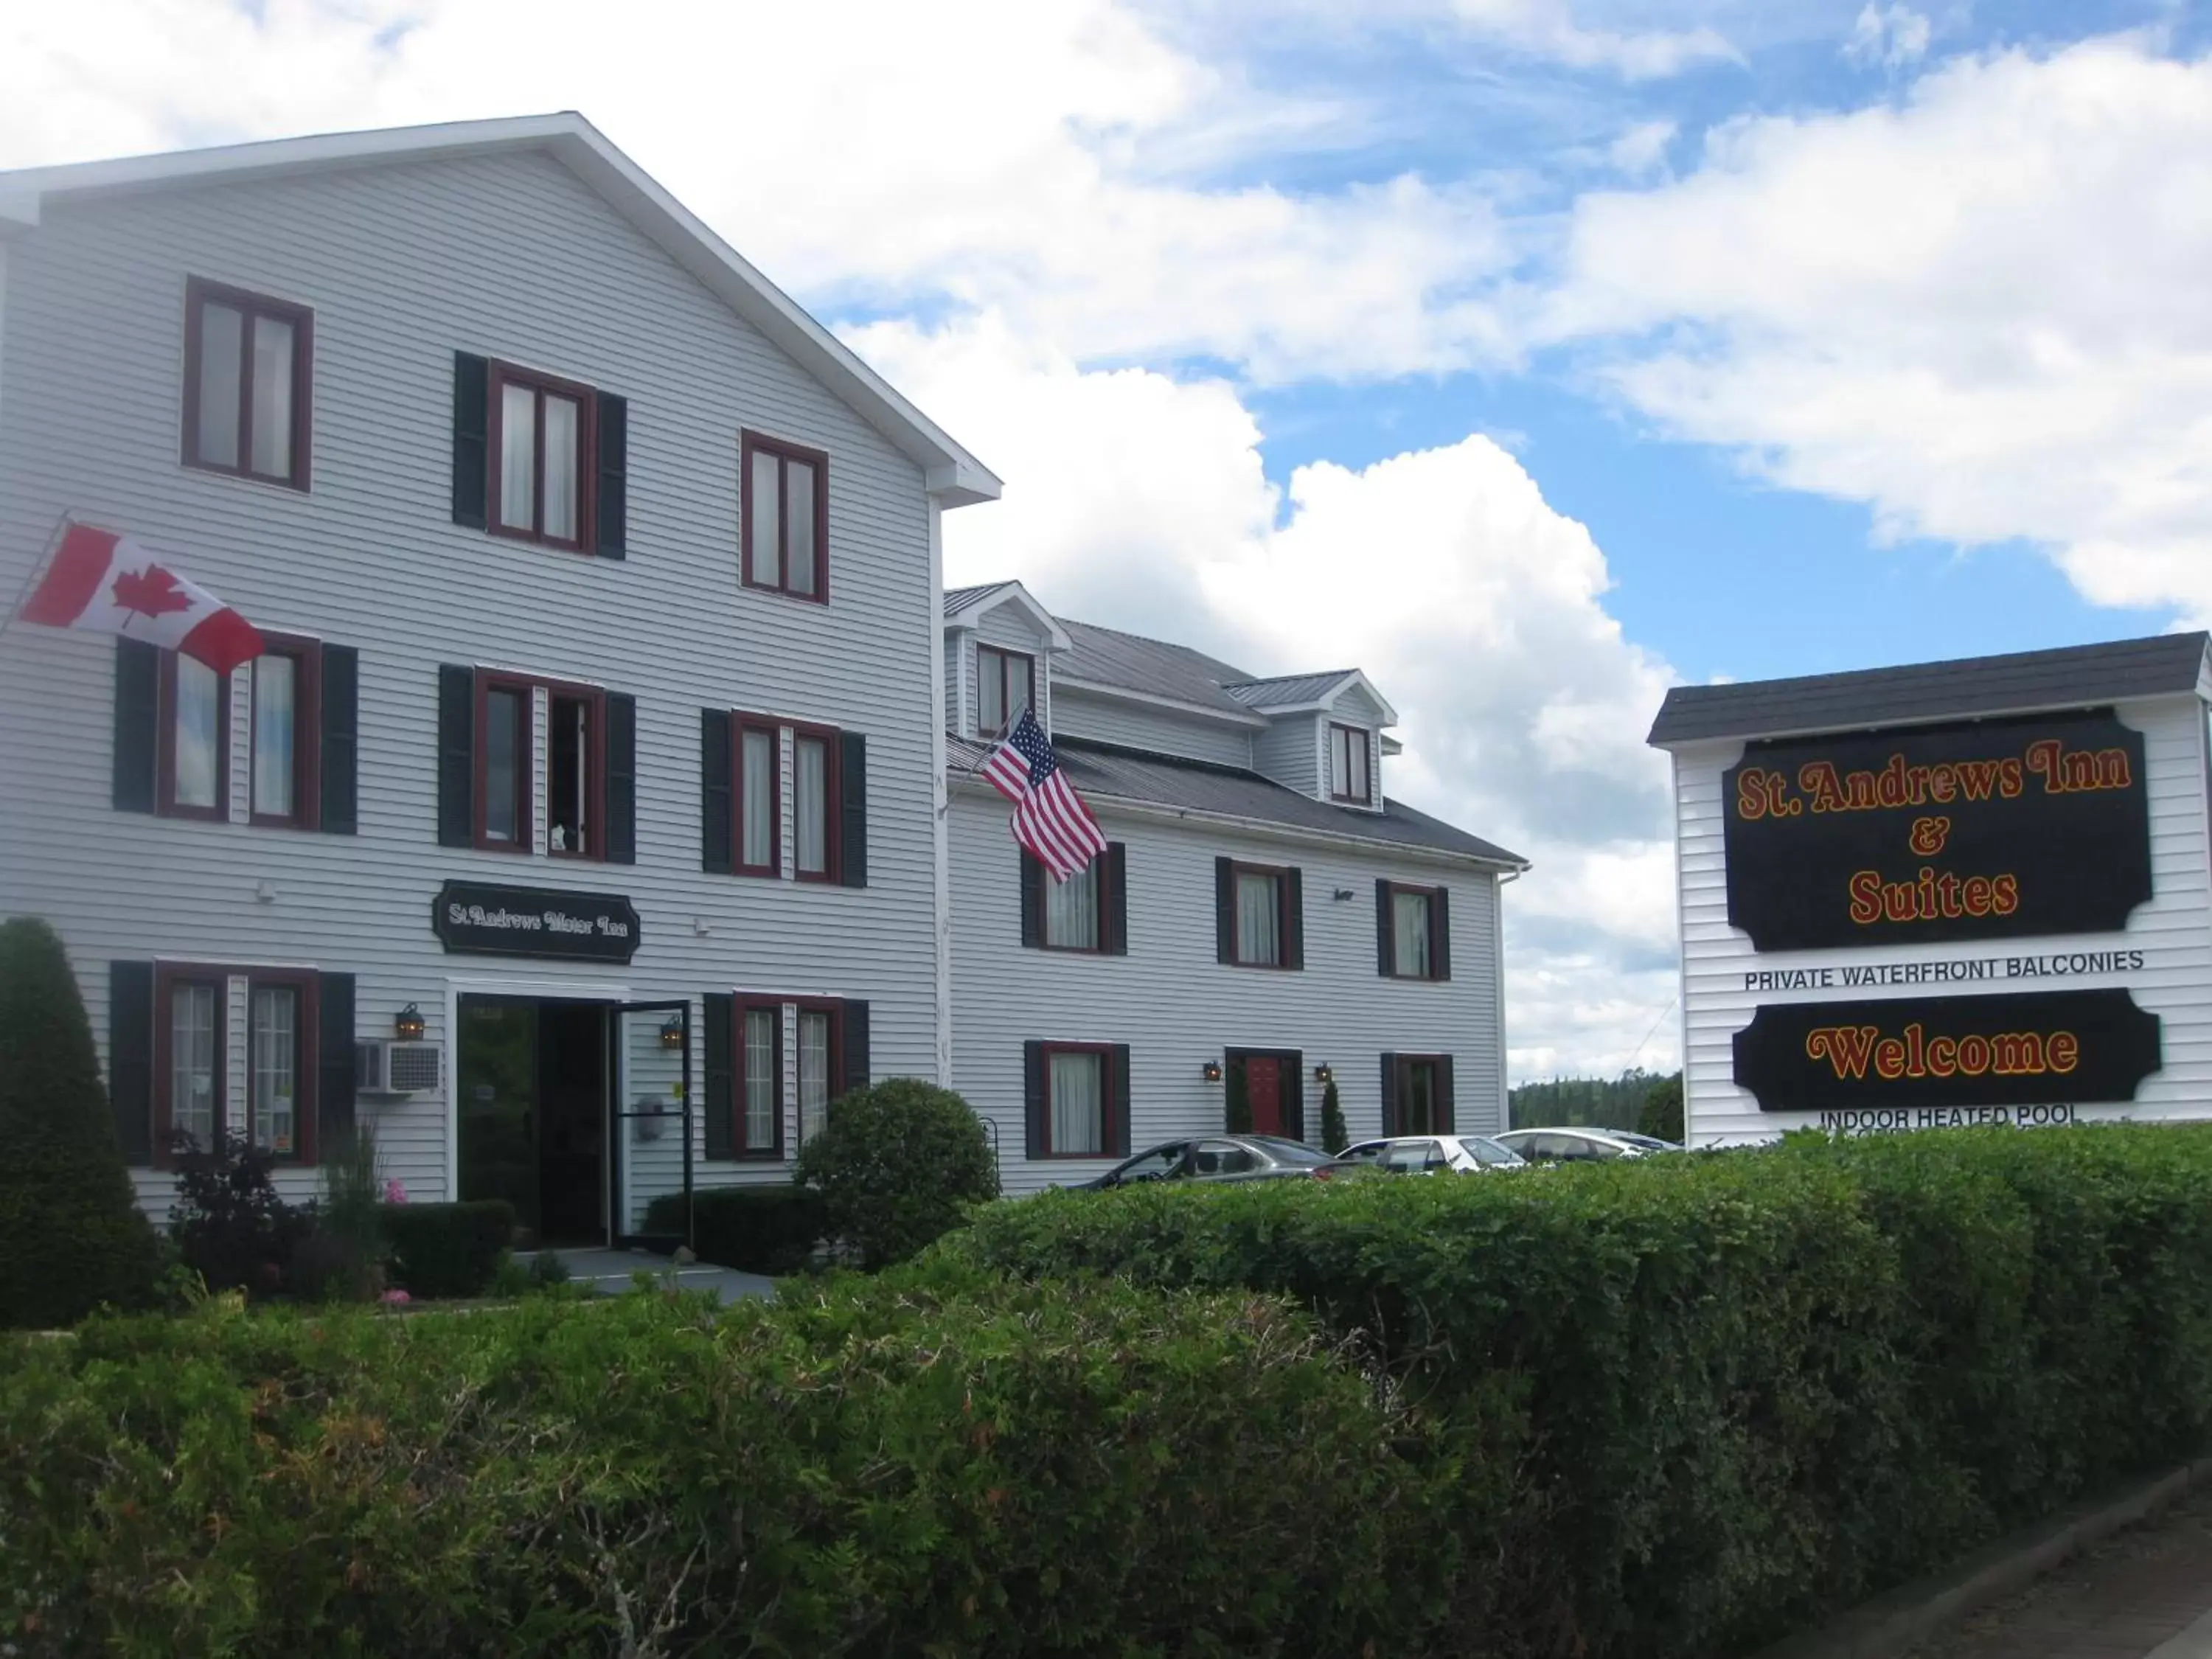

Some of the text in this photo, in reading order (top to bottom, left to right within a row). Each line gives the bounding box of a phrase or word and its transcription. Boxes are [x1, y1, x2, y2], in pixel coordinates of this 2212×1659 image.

[1737, 740, 2132, 820] St. Andrews Inn
[1909, 817, 1950, 855] &
[1849, 866, 2019, 924] Suites
[1745, 950, 2144, 990] PRIVATE WATERFRONT BALCONIES
[1807, 1024, 2079, 1079] Welcome
[1820, 1109, 1909, 1129] INDOOR
[1919, 1107, 2008, 1128] HEATED
